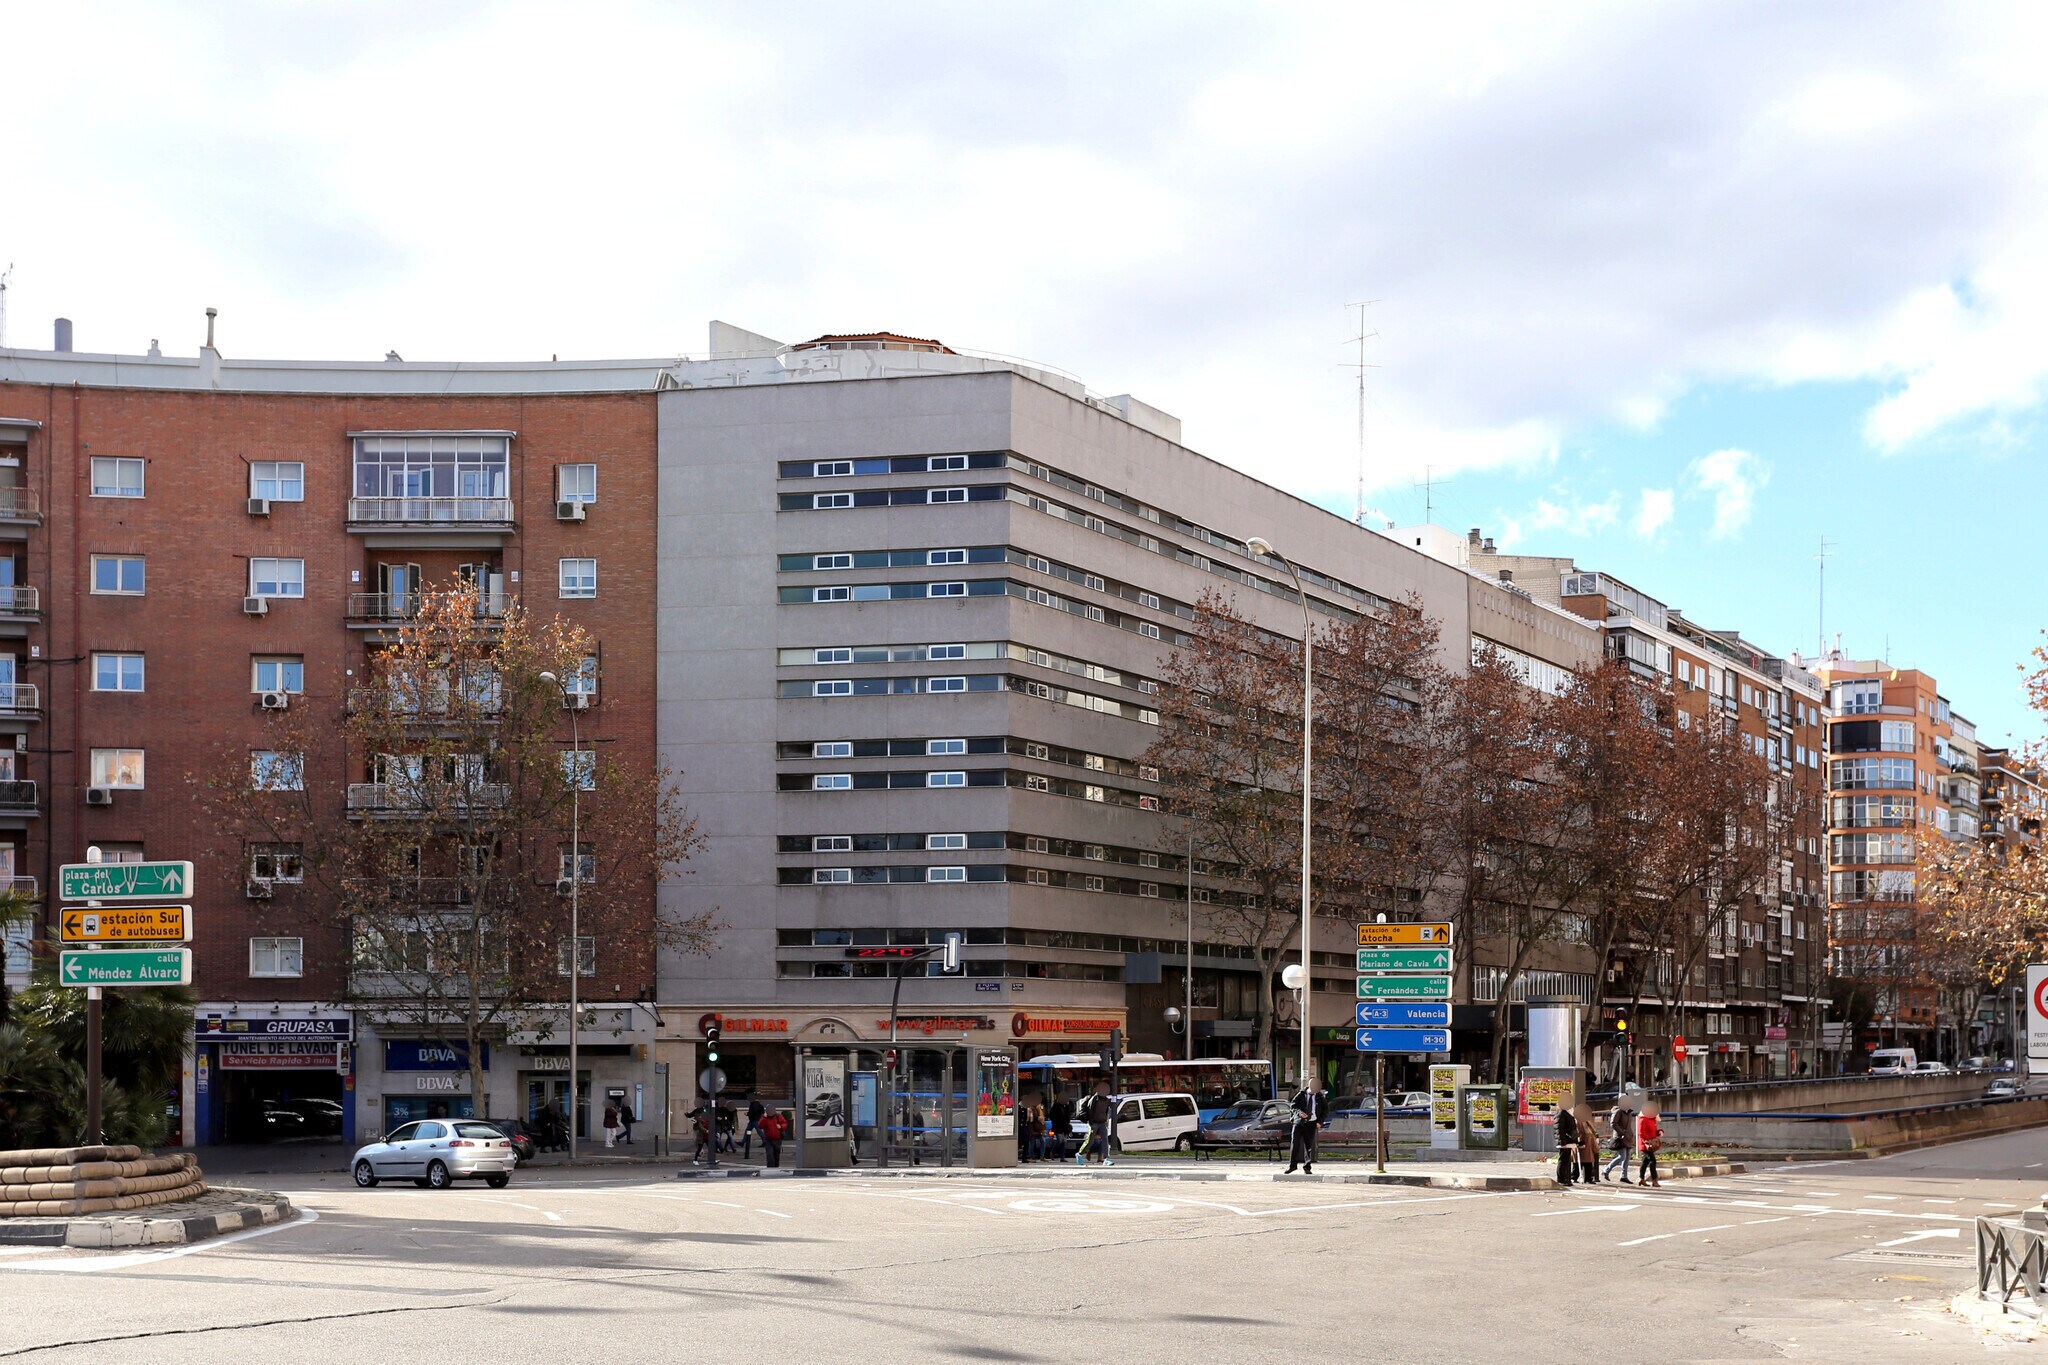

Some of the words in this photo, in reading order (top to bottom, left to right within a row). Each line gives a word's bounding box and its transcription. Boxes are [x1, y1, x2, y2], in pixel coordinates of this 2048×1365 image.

[66, 870, 90, 880] plaza
[94, 870, 108, 878] del
[66, 884, 76, 894] E.
[82, 882, 120, 894] Carlos
[126, 882, 136, 893] V
[102, 913, 152, 924] estación
[160, 912, 180, 923] Sur
[110, 927, 122, 936] de
[128, 926, 180, 936] autobuses
[158, 954, 180, 962] calle
[88, 967, 132, 979] Méndez
[140, 964, 180, 978] Álvaro
[1378, 986, 1418, 994] Fernández
[266, 1022, 334, 1032] GRUPASA
[724, 1019, 788, 1032] GILMAR
[876, 1016, 996, 1034] www.gilmar.es
[269, 1042, 284, 1054] DE
[289, 1042, 337, 1054] LAVADO
[418, 1049, 456, 1061] BBVA
[270, 1057, 302, 1066] Rapido
[534, 1058, 570, 1070] BBVA
[416, 1078, 454, 1090] BBVA
[807, 1074, 824, 1088] KUGA
[394, 1108, 408, 1116] 3%
